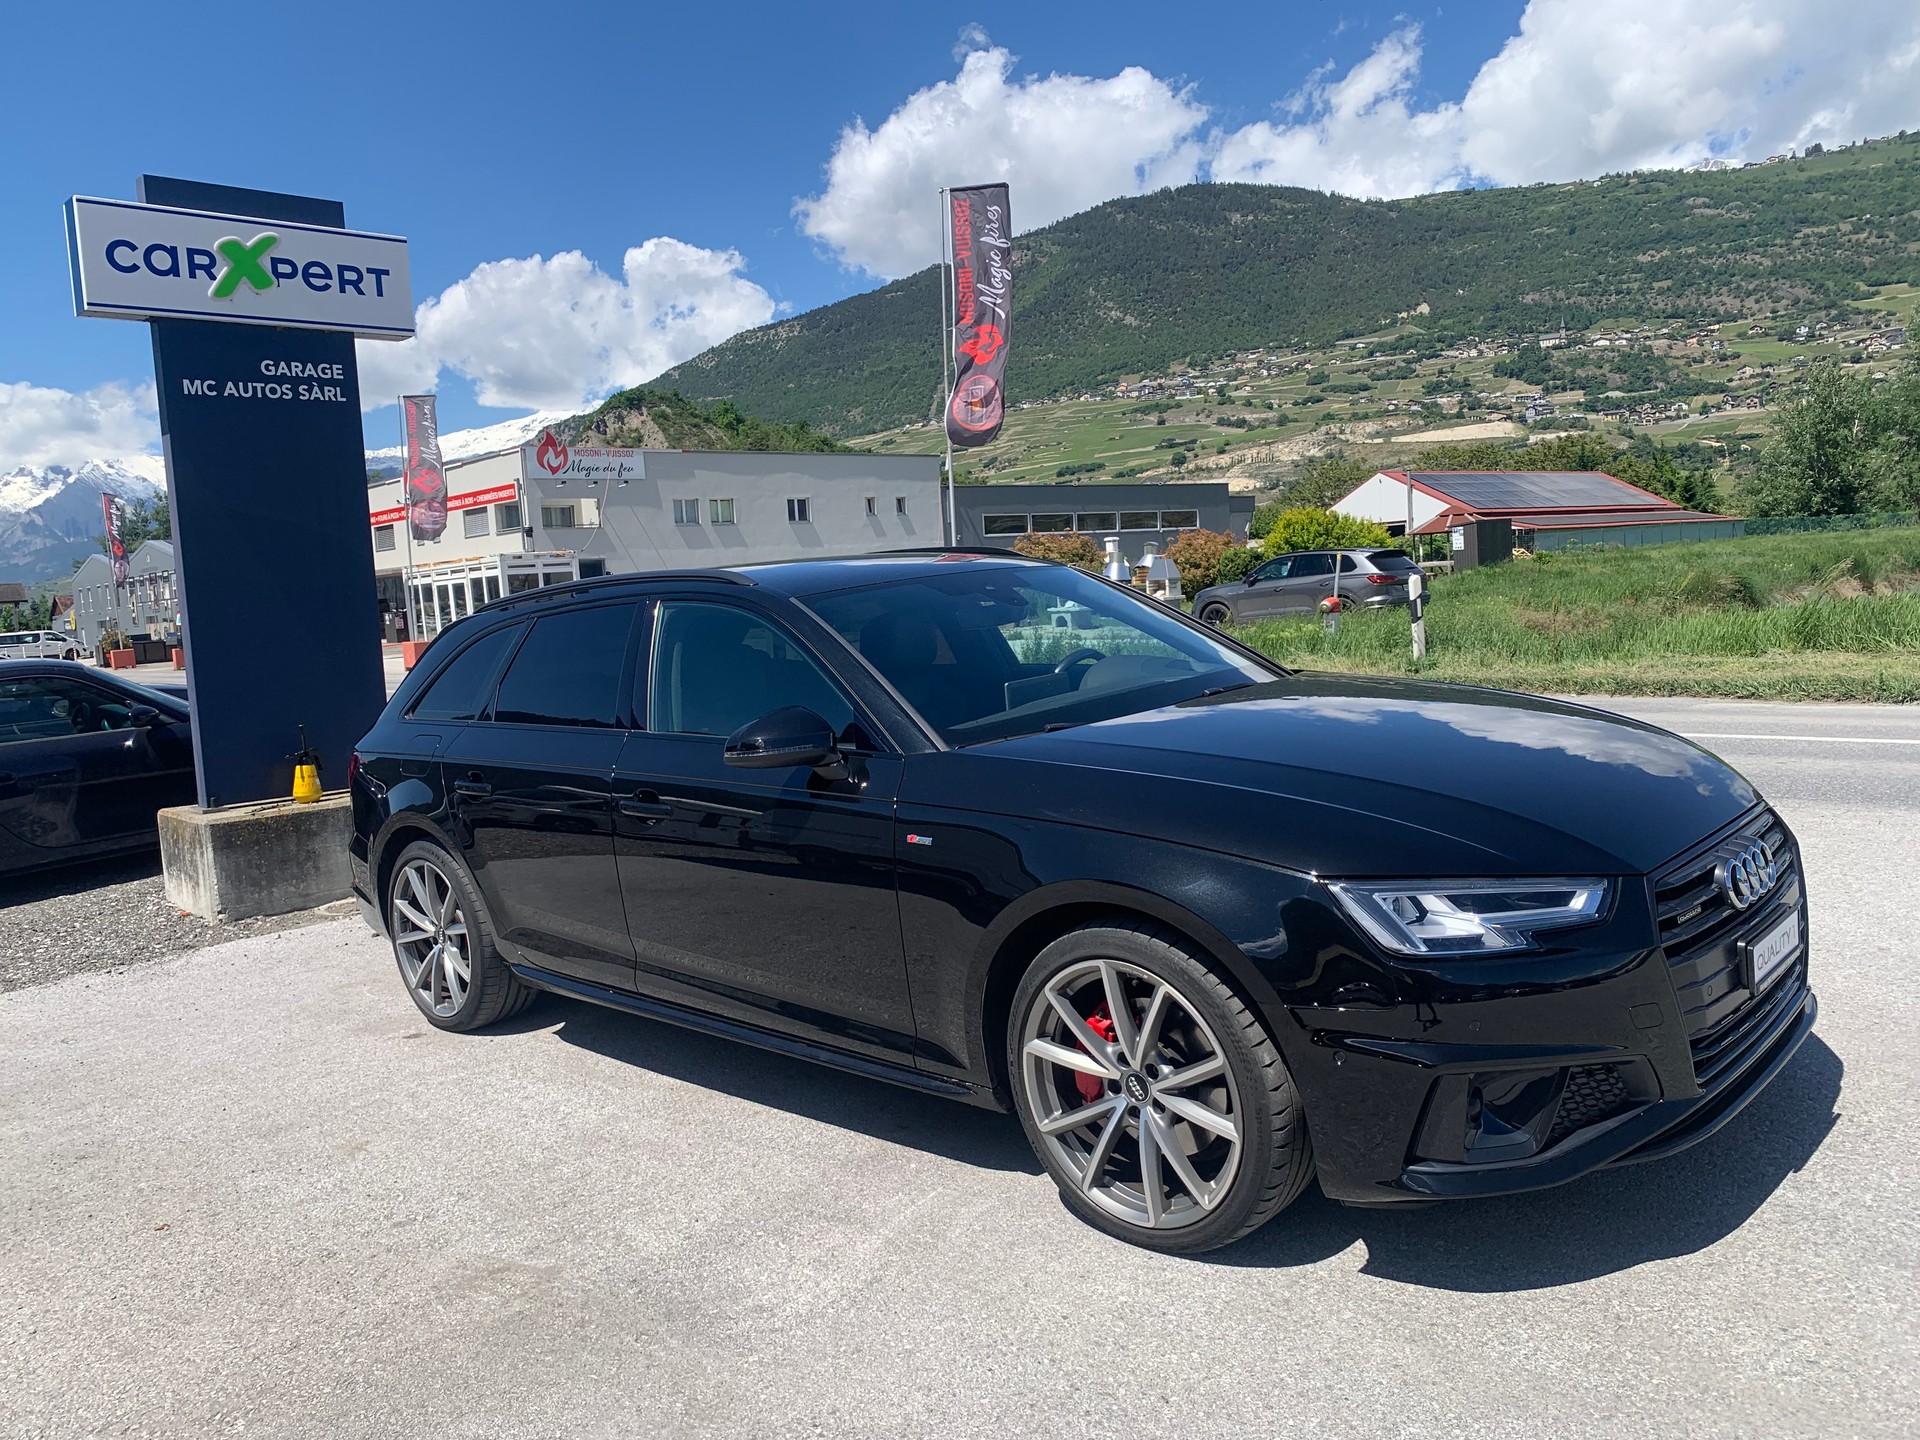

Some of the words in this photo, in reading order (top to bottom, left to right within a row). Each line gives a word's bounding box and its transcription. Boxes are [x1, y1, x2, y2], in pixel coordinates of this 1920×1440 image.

[979, 204, 1011, 248] fires
[953, 198, 976, 325] MOSONI-VUISSOZ
[976, 249, 1012, 320] Magic
[260, 360, 344, 380] GARAGE
[182, 379, 218, 396] MC
[224, 381, 293, 399] AUTOS
[299, 382, 347, 402] SÀRL
[562, 459, 602, 478] Magie
[602, 462, 617, 473] du
[617, 461, 635, 478] feu
[573, 448, 635, 458] MOSONI-VUISSOZ
[1756, 927, 1791, 971] QUALITY
